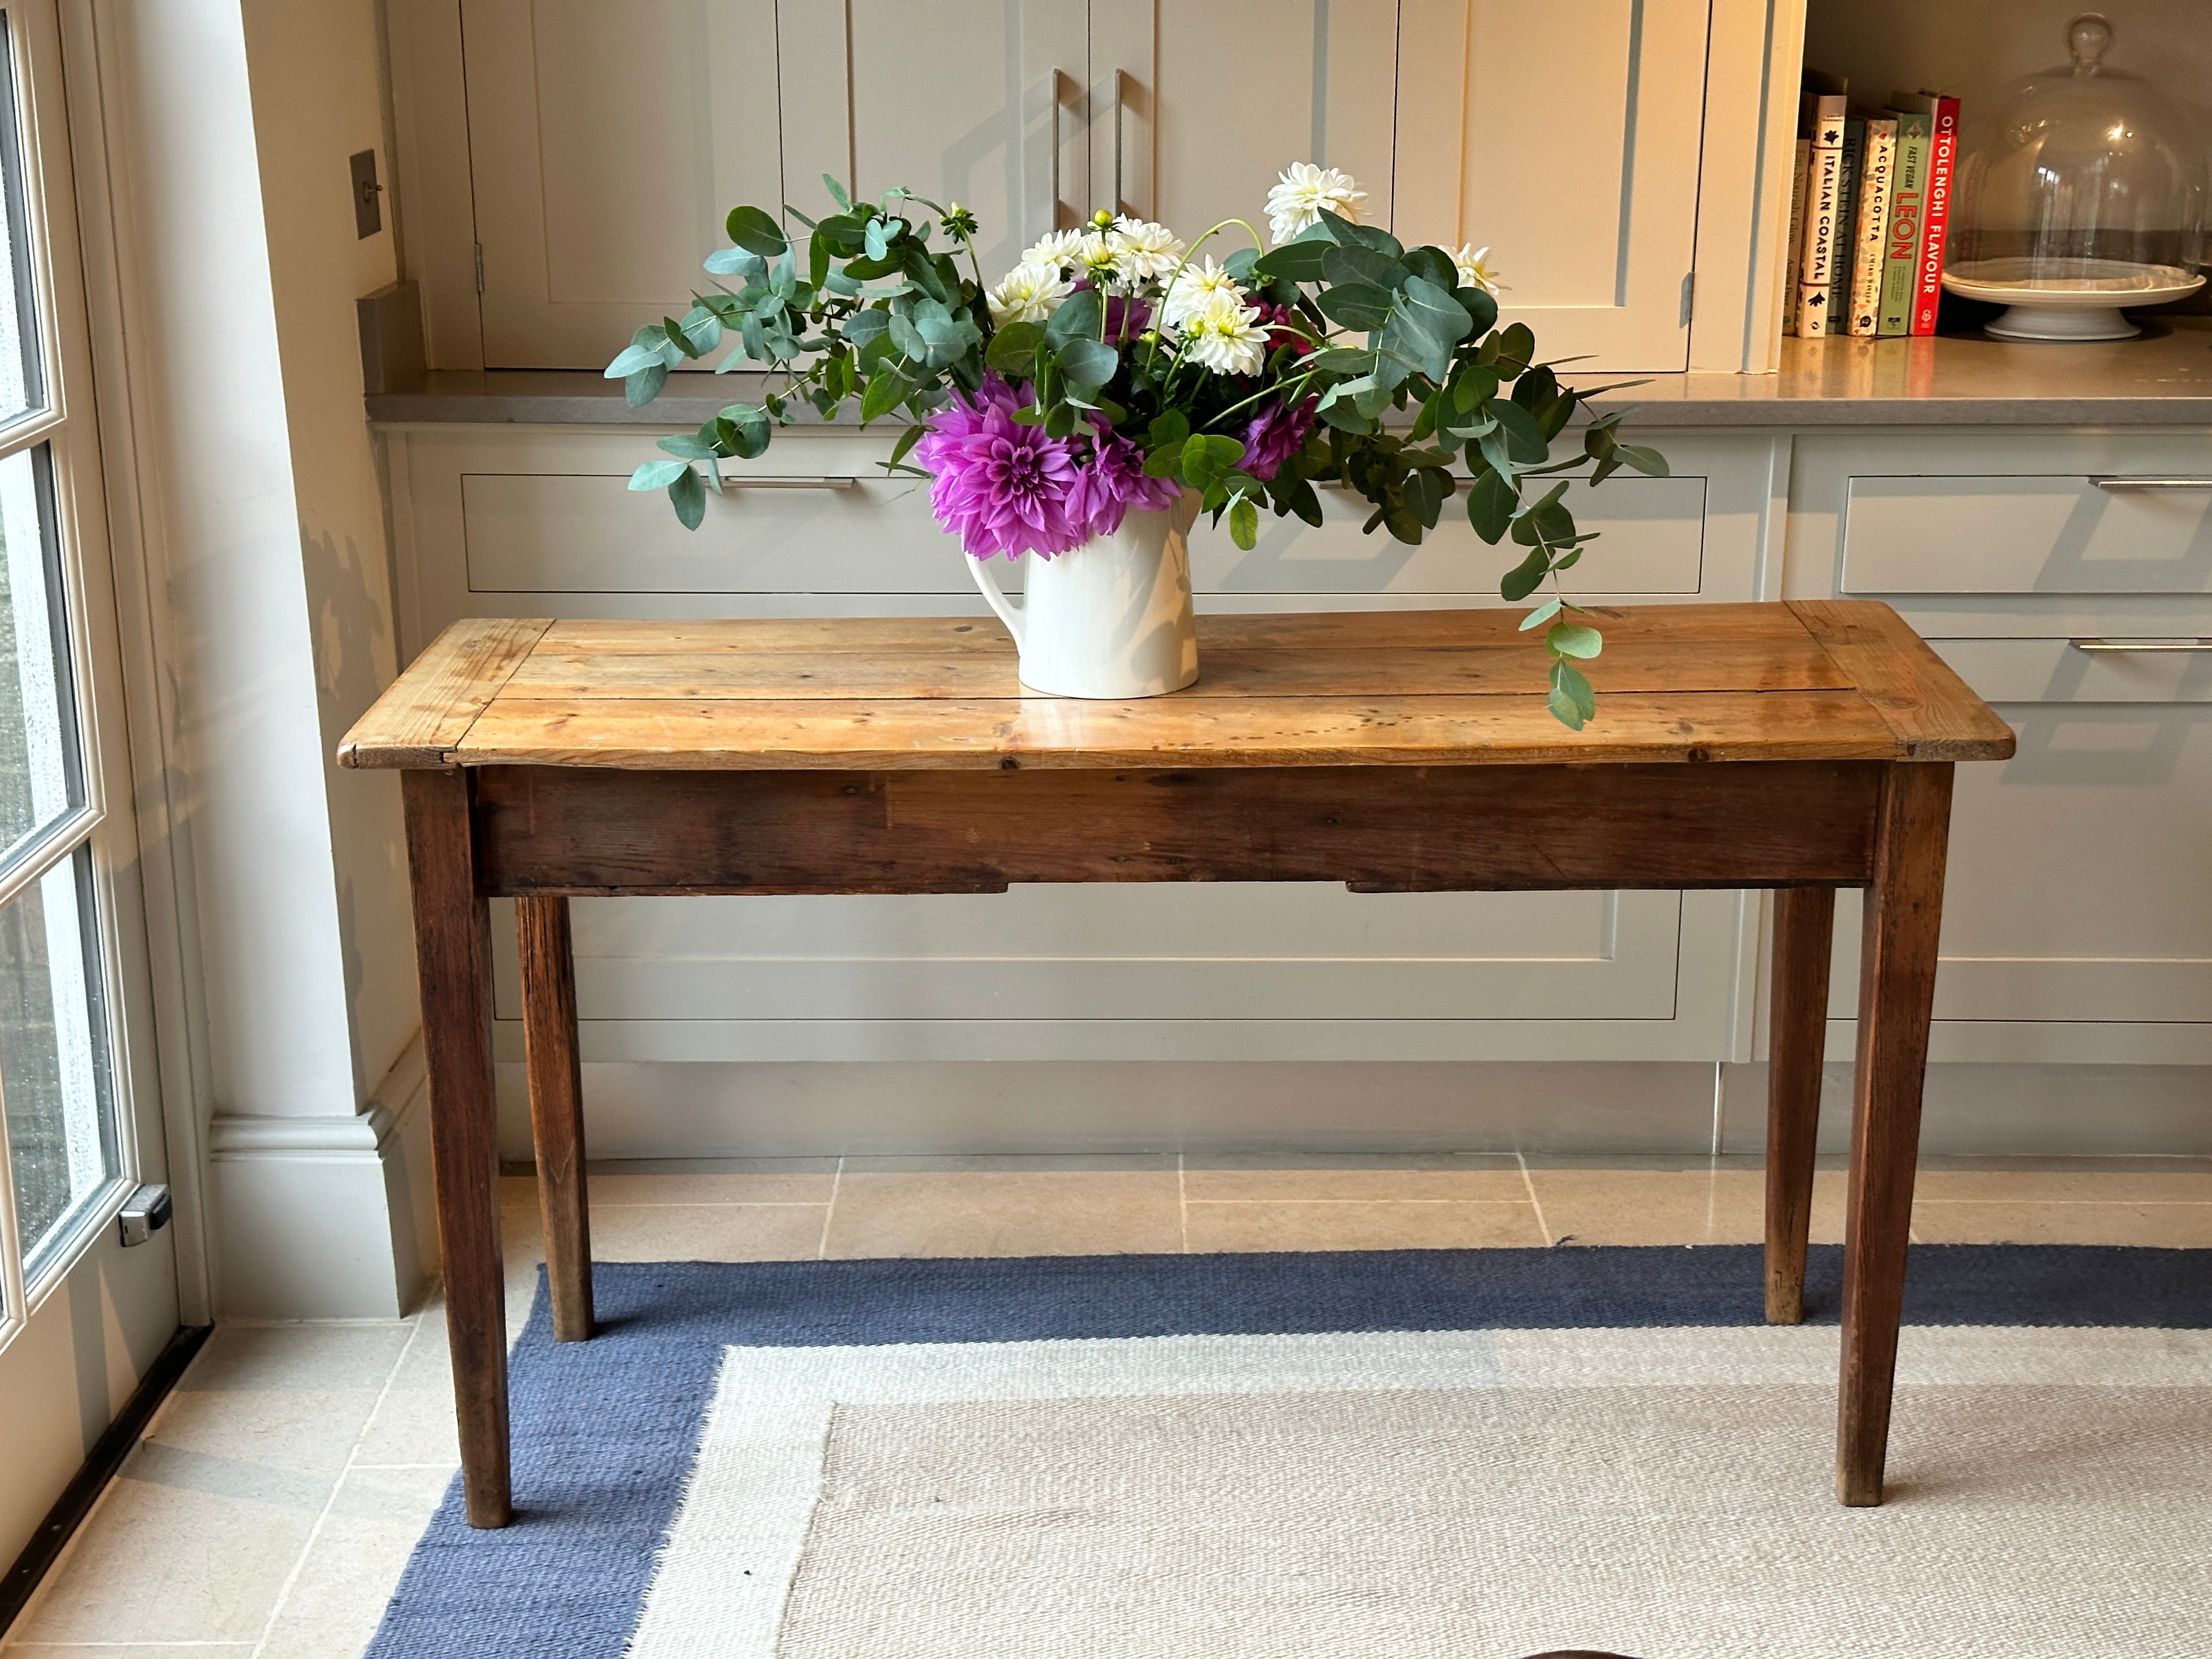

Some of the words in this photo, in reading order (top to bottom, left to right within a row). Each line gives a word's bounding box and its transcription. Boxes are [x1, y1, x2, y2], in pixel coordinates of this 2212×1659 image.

[1820, 156, 1835, 211] ITALIAN
[1842, 138, 1856, 176] RICK
[1904, 166, 1915, 189] VEGAN
[1908, 145, 1917, 164] FAST
[1932, 116, 1953, 216] OTTOLENGHI
[1870, 145, 1888, 241] ACQUACOTTA
[1814, 216, 1830, 279] COASTAL
[1891, 193, 1919, 259] LEON
[1923, 225, 1942, 294] FLAVOUR
